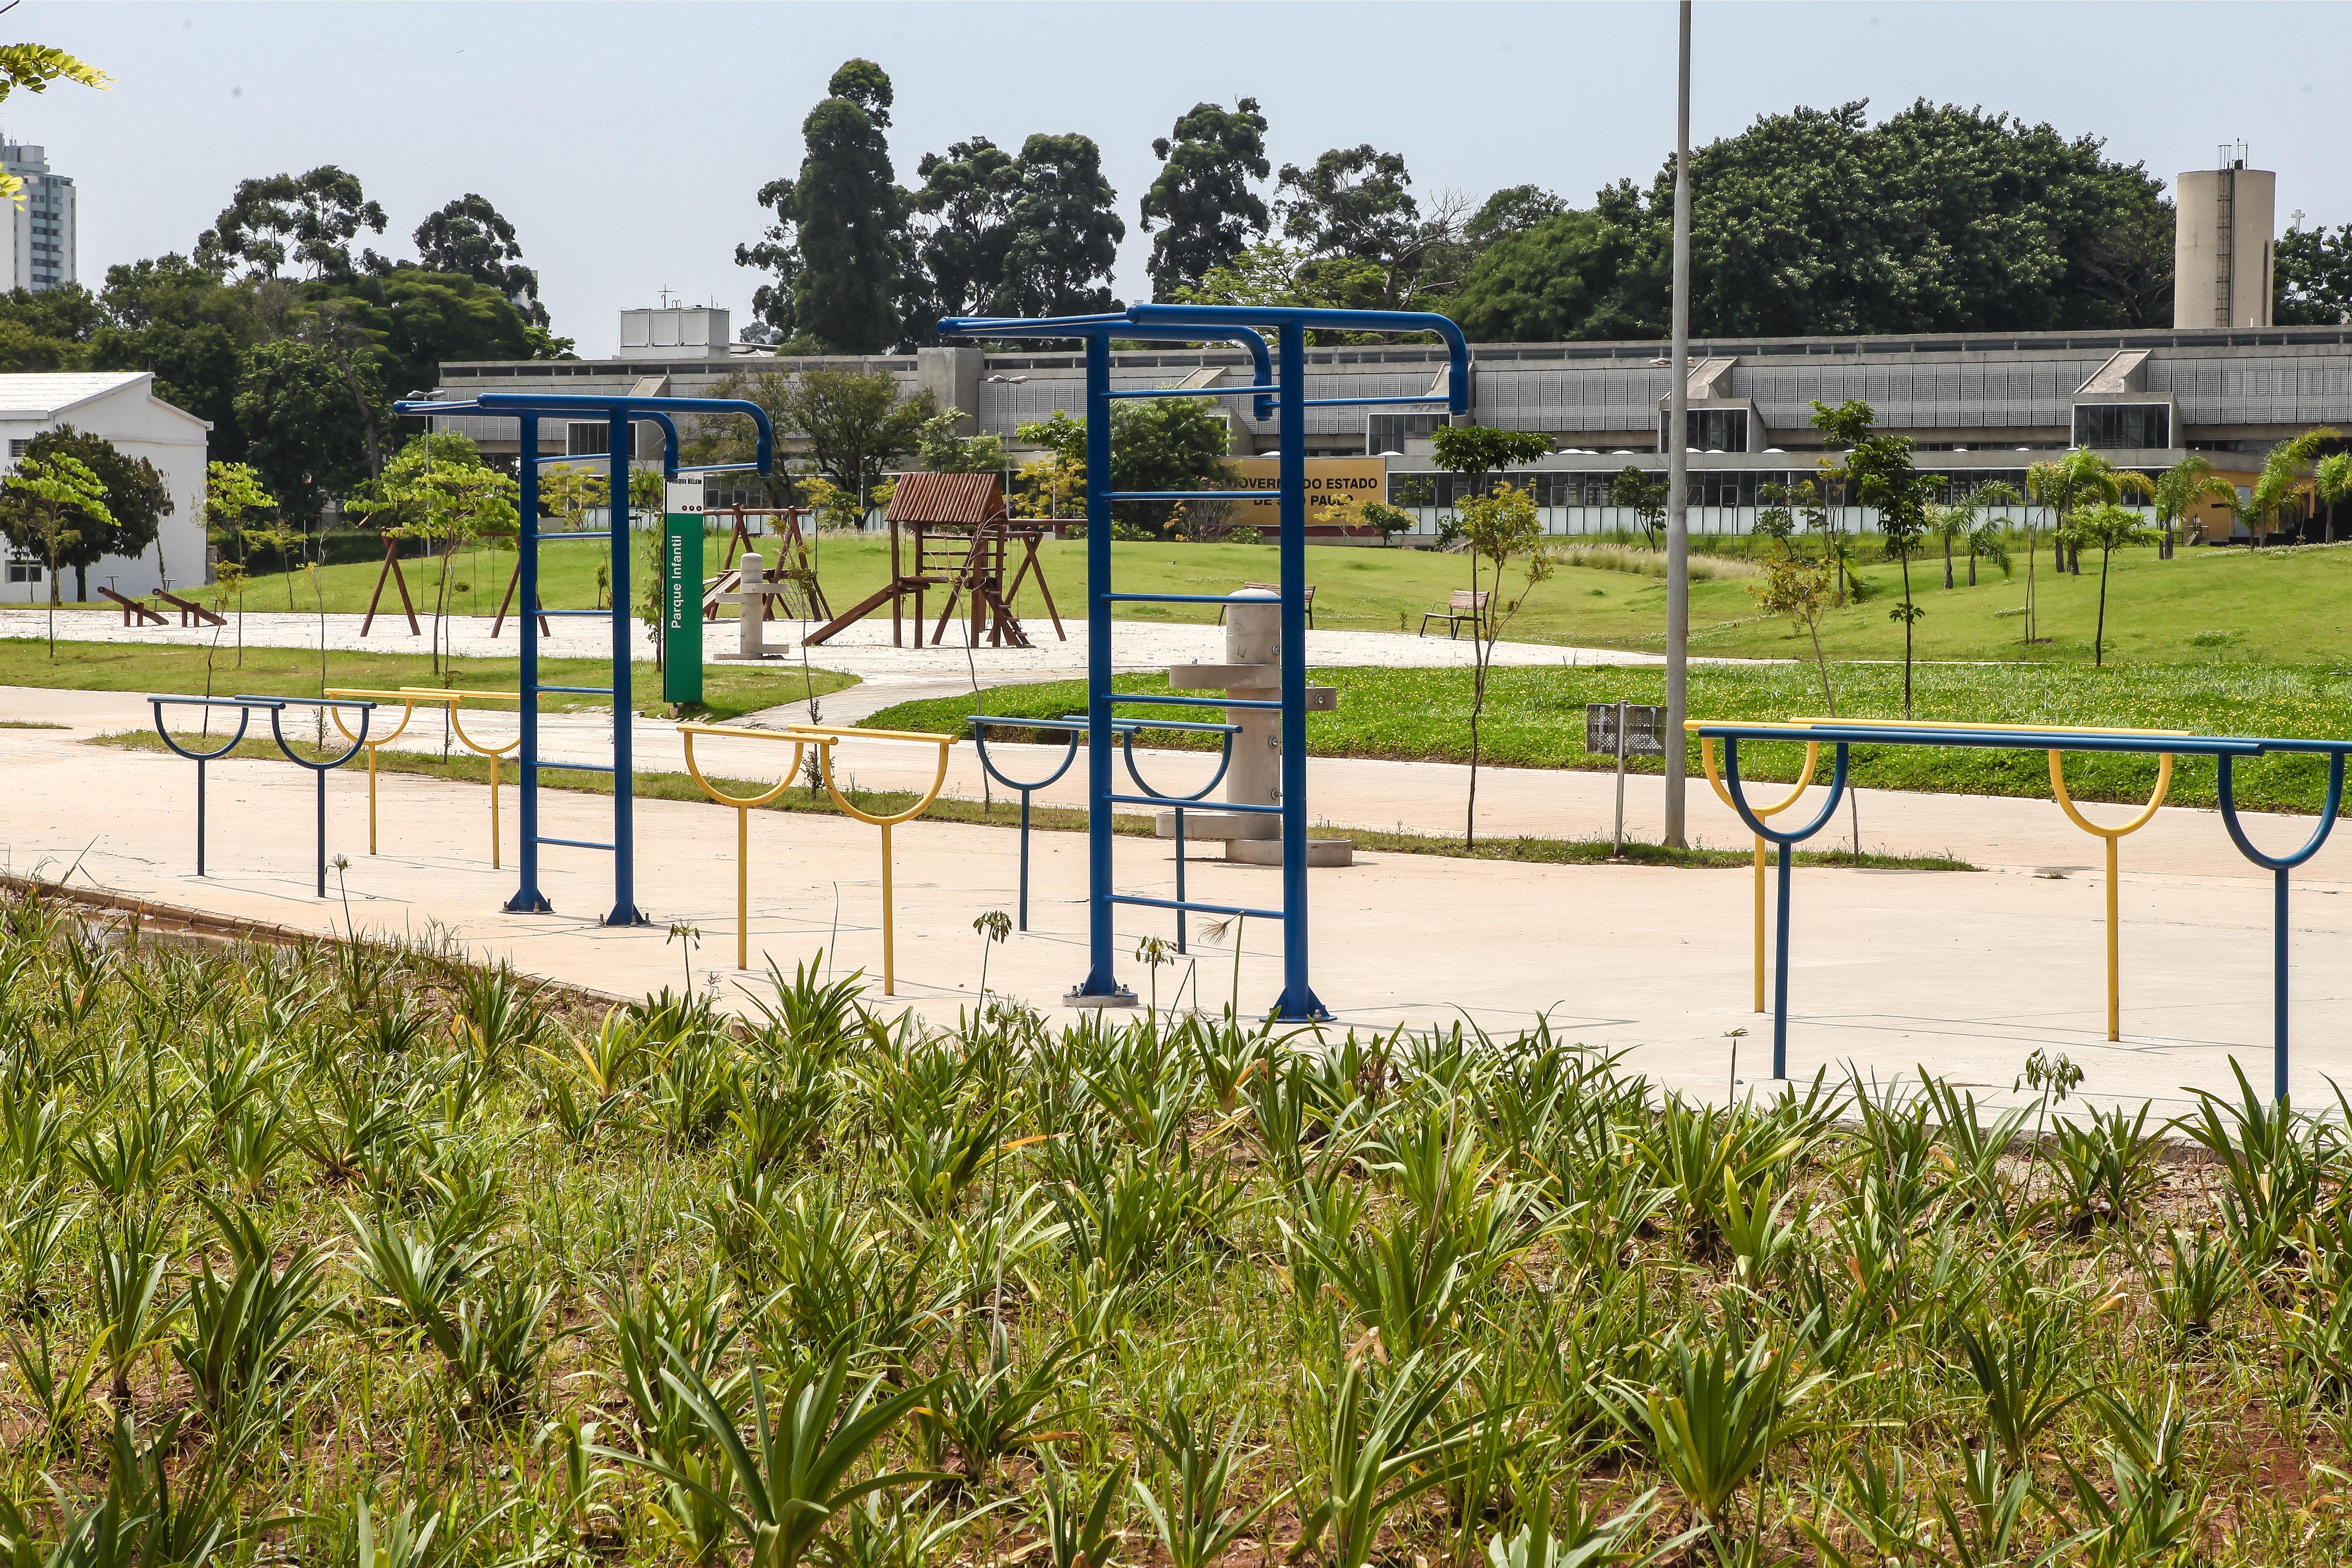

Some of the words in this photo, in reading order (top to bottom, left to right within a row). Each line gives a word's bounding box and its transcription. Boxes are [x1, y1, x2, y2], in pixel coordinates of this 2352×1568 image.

[1233, 478, 1281, 489] OVER
[1304, 478, 1322, 489] DO
[1327, 478, 1378, 489] ESTADO
[671, 535, 682, 579] Infantil
[671, 583, 684, 628] Parque
